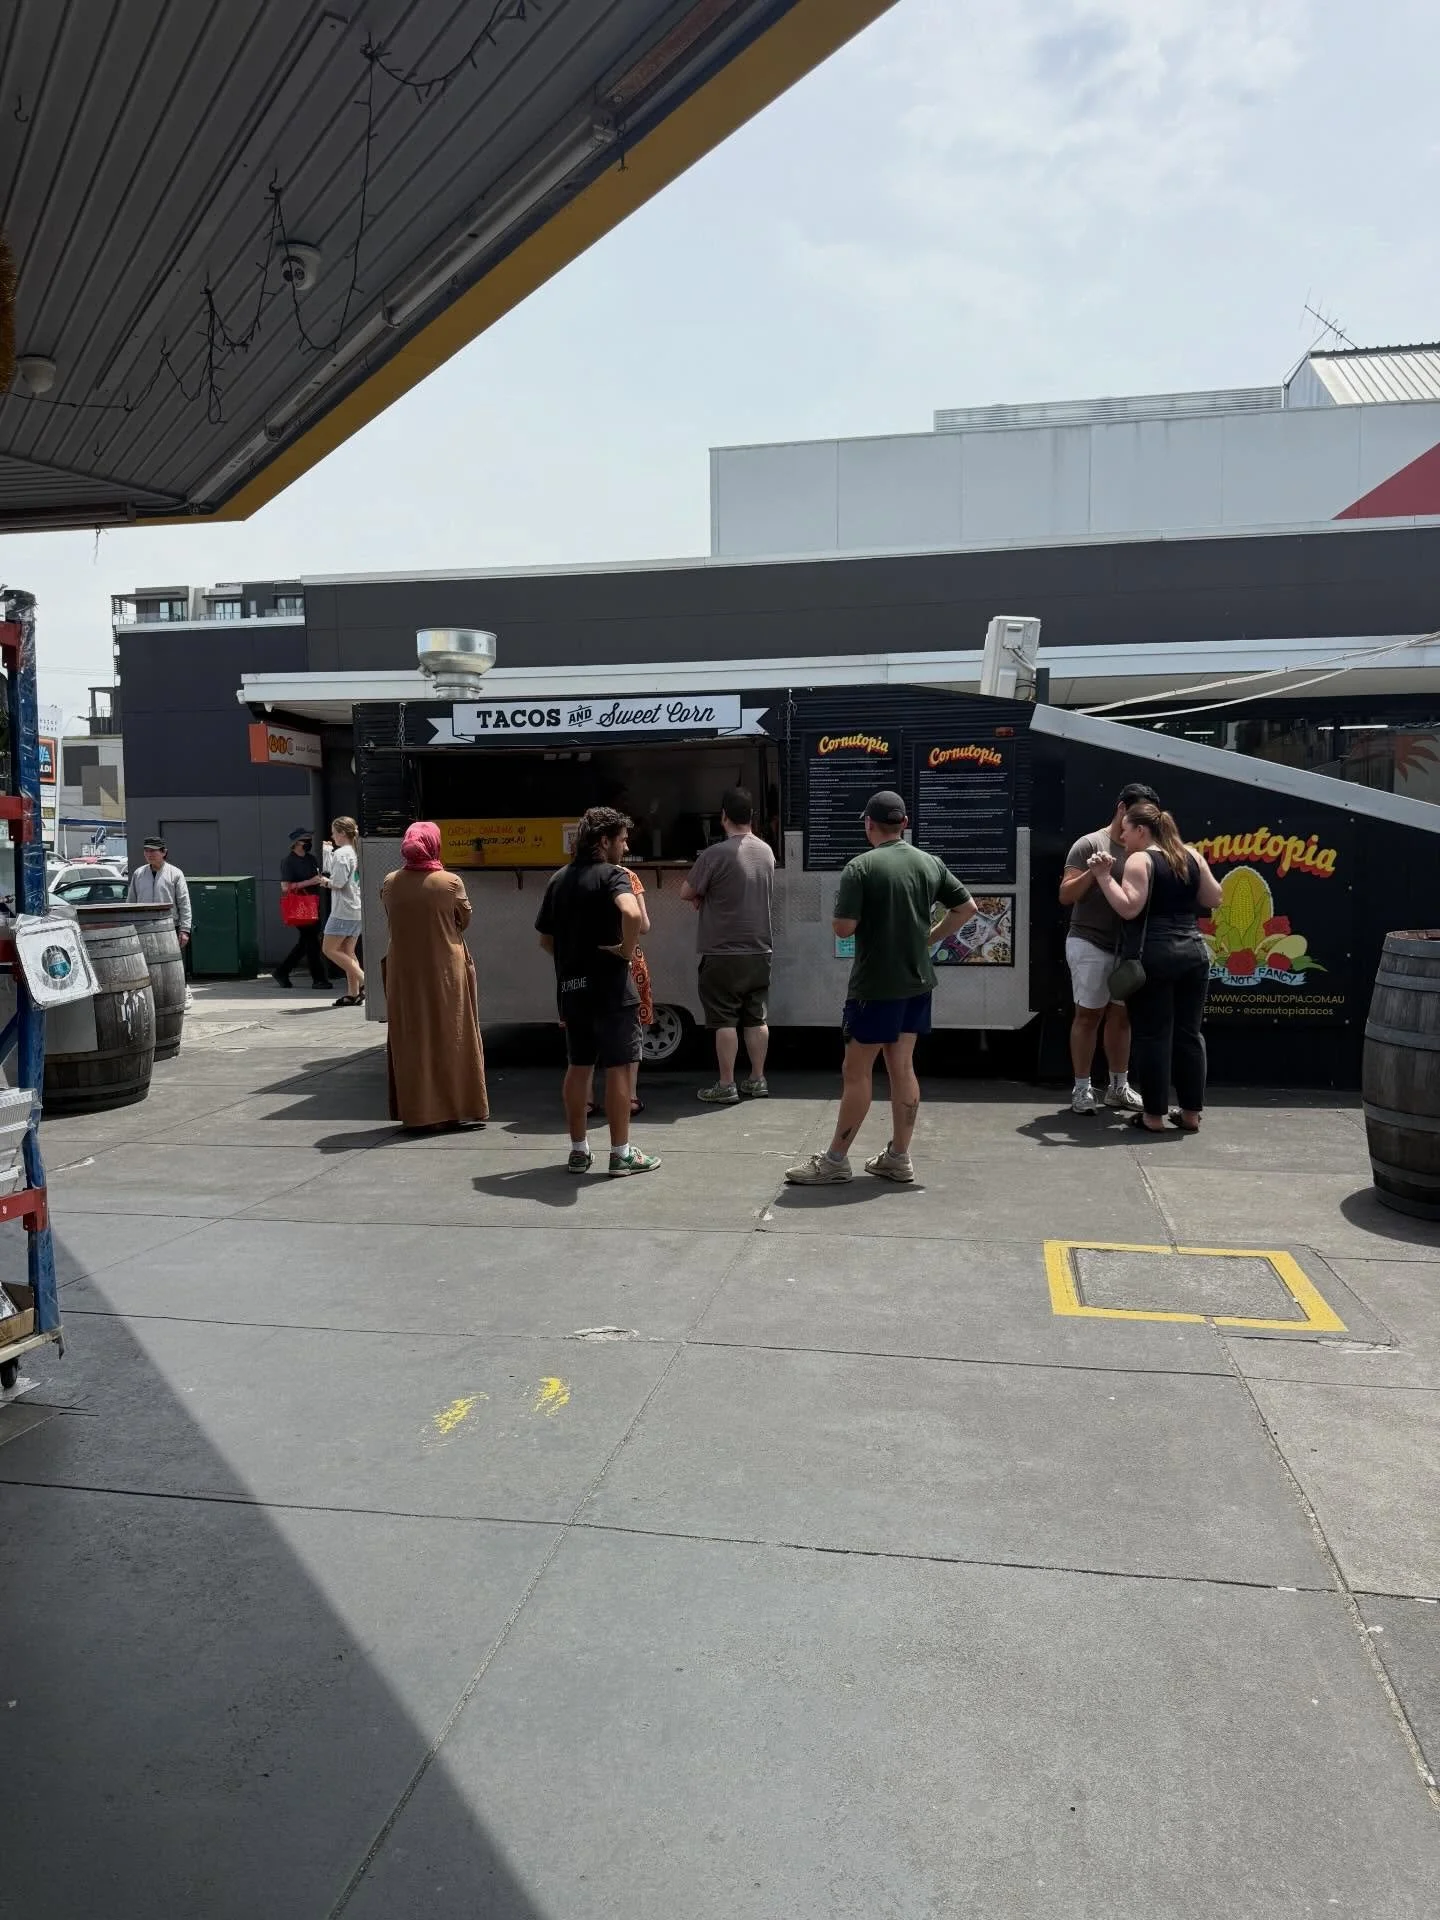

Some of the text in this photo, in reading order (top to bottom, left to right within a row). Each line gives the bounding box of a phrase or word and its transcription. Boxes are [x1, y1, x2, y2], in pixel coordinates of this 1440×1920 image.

[476, 701, 716, 729] TACOS AND Sweet Corn
[818, 732, 889, 756] Cornutopia
[927, 743, 1002, 767] Cornutopia
[1209, 967, 1298, 985] SH NOT FANCY
[1210, 993, 1345, 1004] WWW.CORNUTOPIA.COM.AU
[1203, 1005, 1234, 1014] ERING
